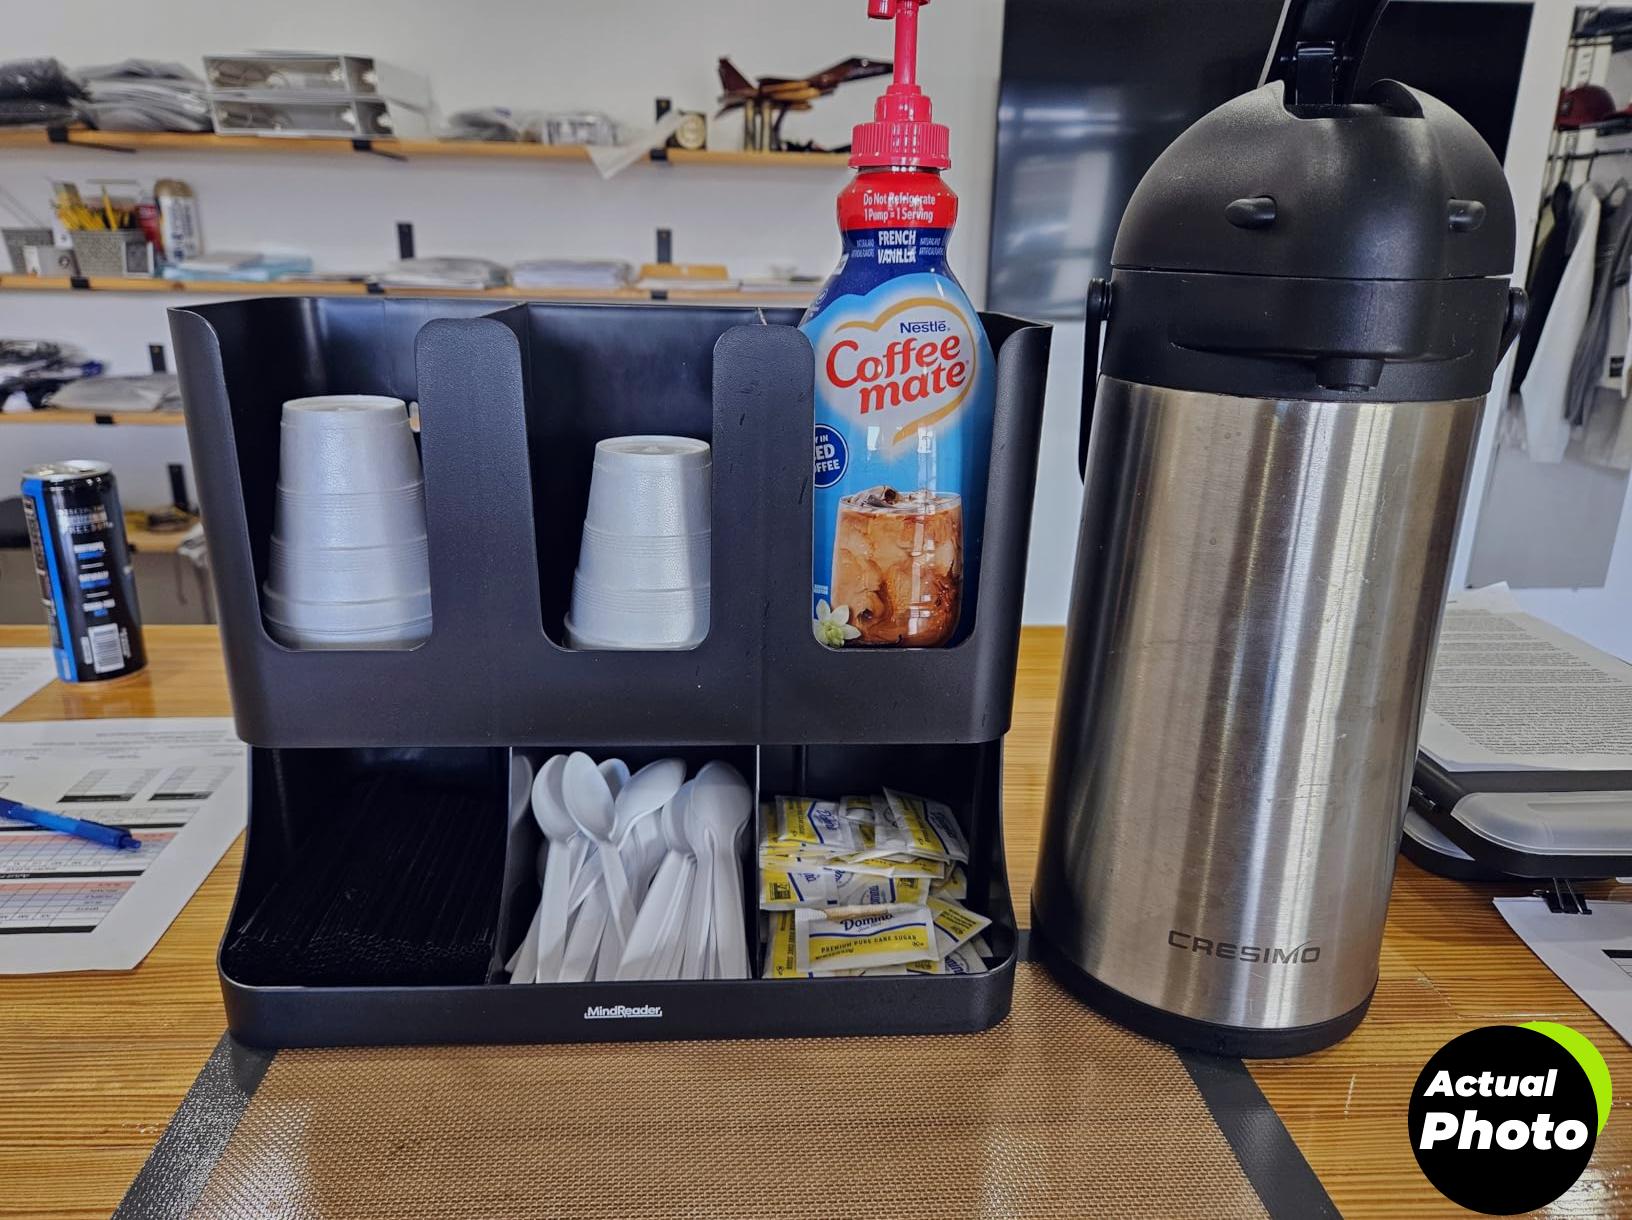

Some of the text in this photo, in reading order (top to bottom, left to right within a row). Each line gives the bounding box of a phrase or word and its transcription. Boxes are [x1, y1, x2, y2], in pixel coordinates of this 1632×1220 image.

[863, 192, 936, 207] Do Not Refrigerate
[868, 209, 888, 222] Pump
[896, 207, 900, 220] 1
[901, 207, 934, 223] Serving
[878, 230, 916, 245] FRENCH
[878, 247, 916, 264] VANILLA
[826, 335, 961, 388] Coffee
[860, 361, 966, 414] mate
[815, 443, 835, 460] ED
[815, 459, 840, 472] FFEE
[821, 942, 851, 953] PREMIUM
[874, 935, 891, 943] CANE
[1168, 930, 1320, 964] CRESIMO
[587, 1004, 661, 1017] MindReader
